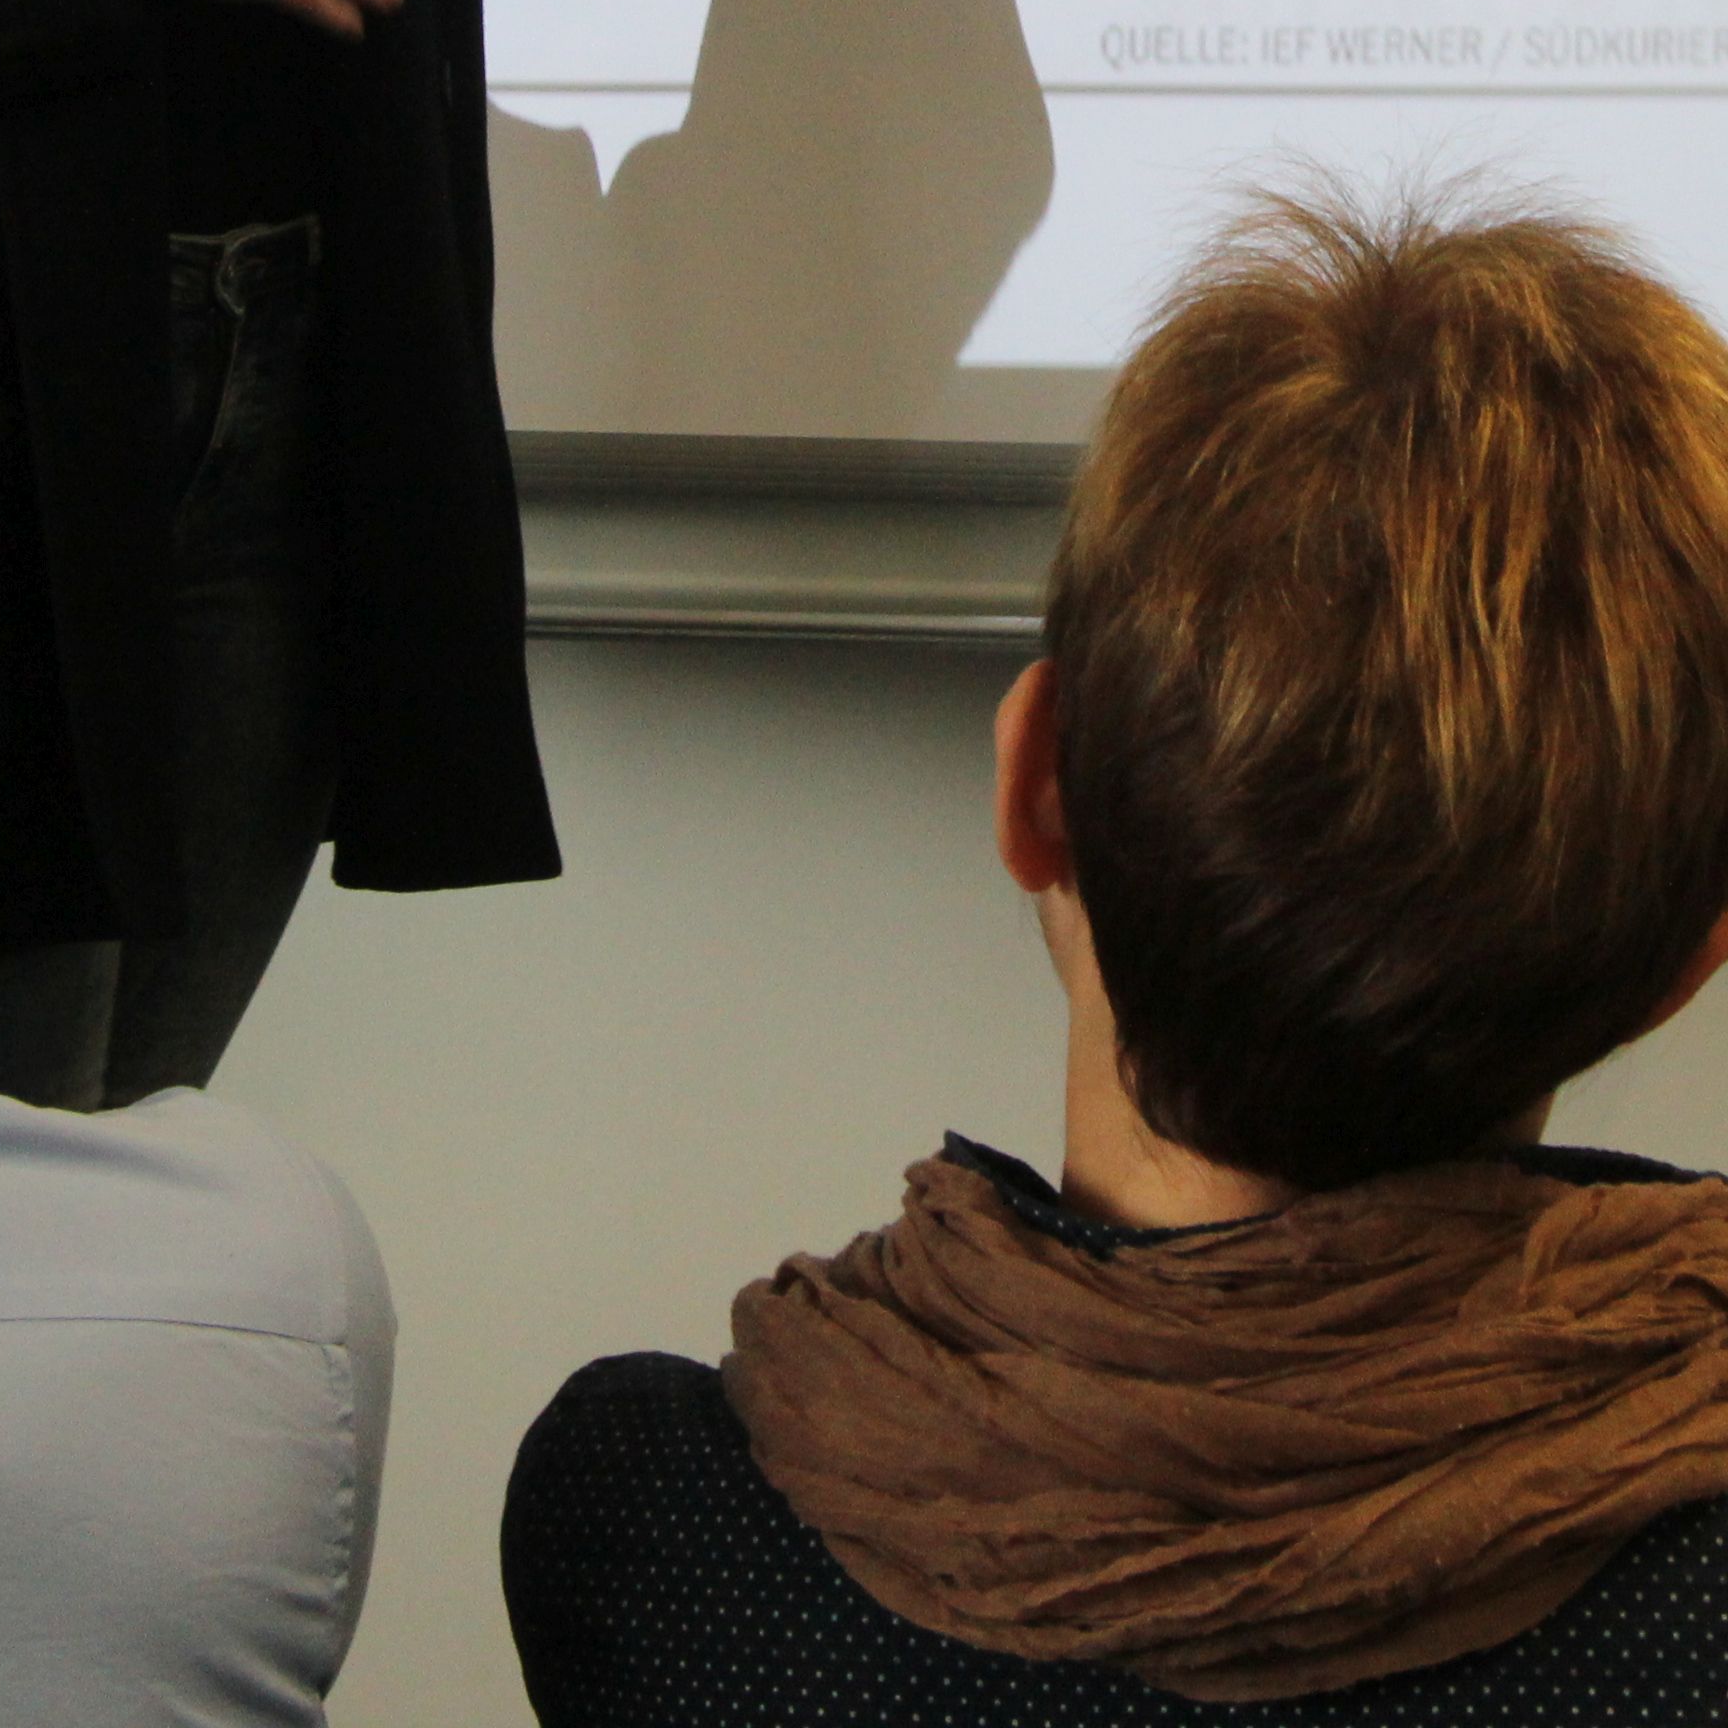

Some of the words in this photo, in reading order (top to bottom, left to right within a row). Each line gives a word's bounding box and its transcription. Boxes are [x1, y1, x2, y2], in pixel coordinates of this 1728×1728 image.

[1100, 23, 1249, 69] QUELLE:
[1260, 26, 1314, 65] IEF
[1327, 26, 1484, 65] WERNER
